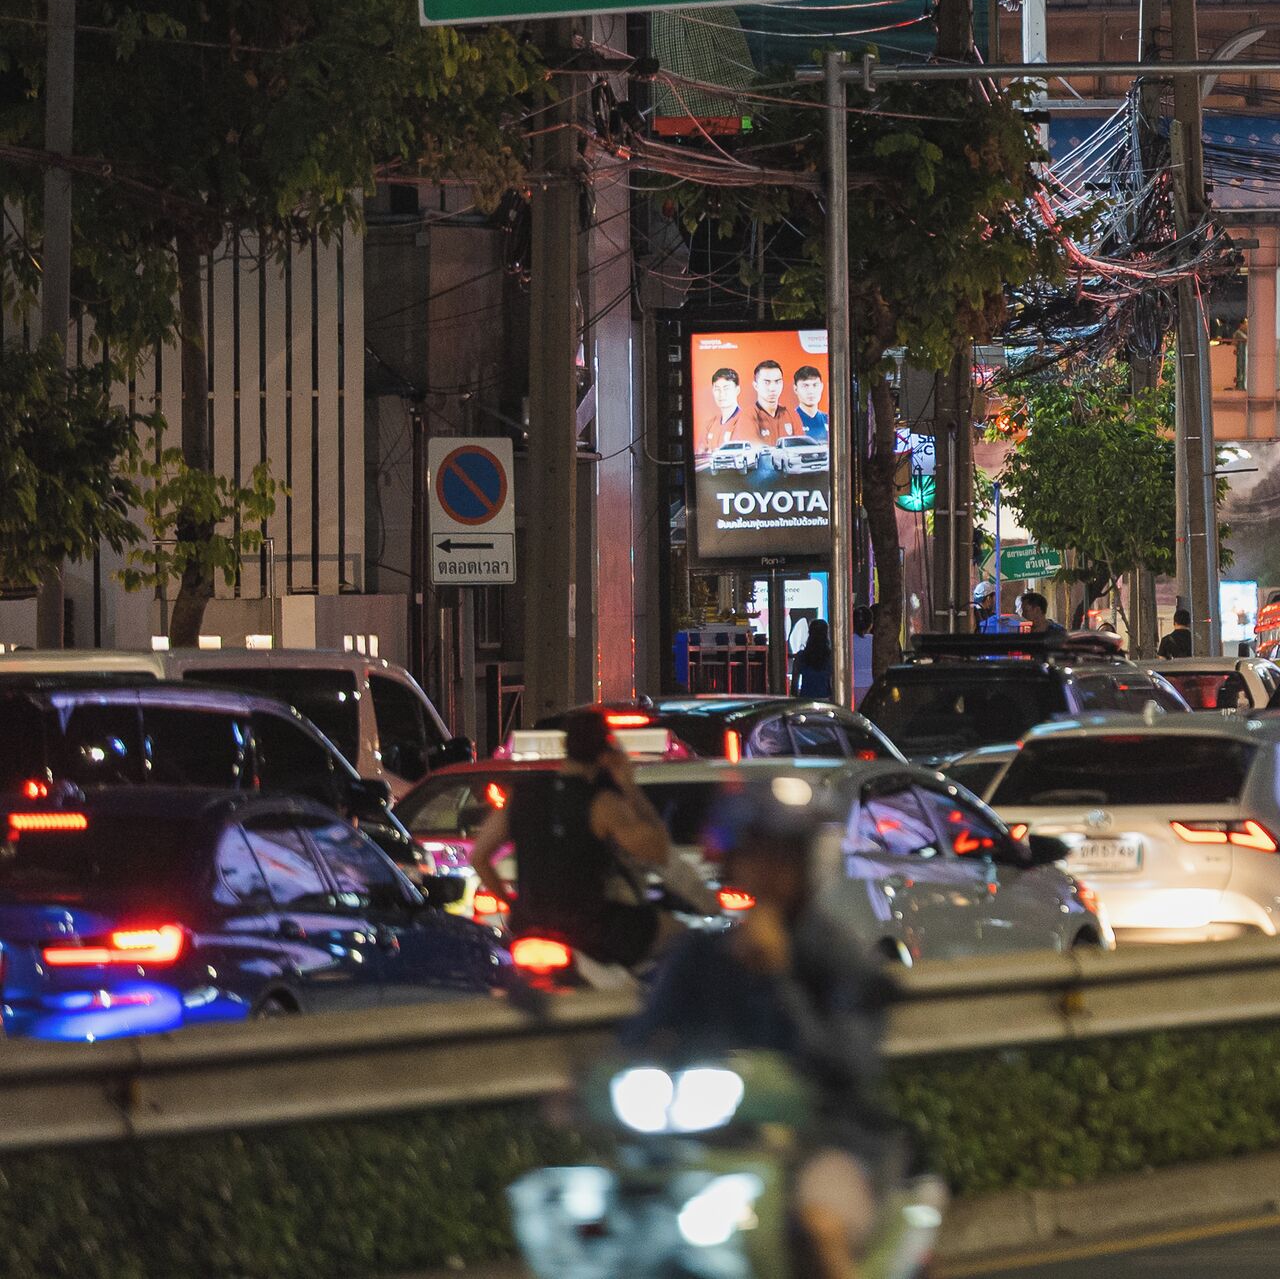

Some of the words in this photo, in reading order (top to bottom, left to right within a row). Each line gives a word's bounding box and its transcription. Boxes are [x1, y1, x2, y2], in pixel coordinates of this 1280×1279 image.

[715, 489, 829, 515] TOYOTA
[437, 558, 510, 577] ตลอดเวลา
